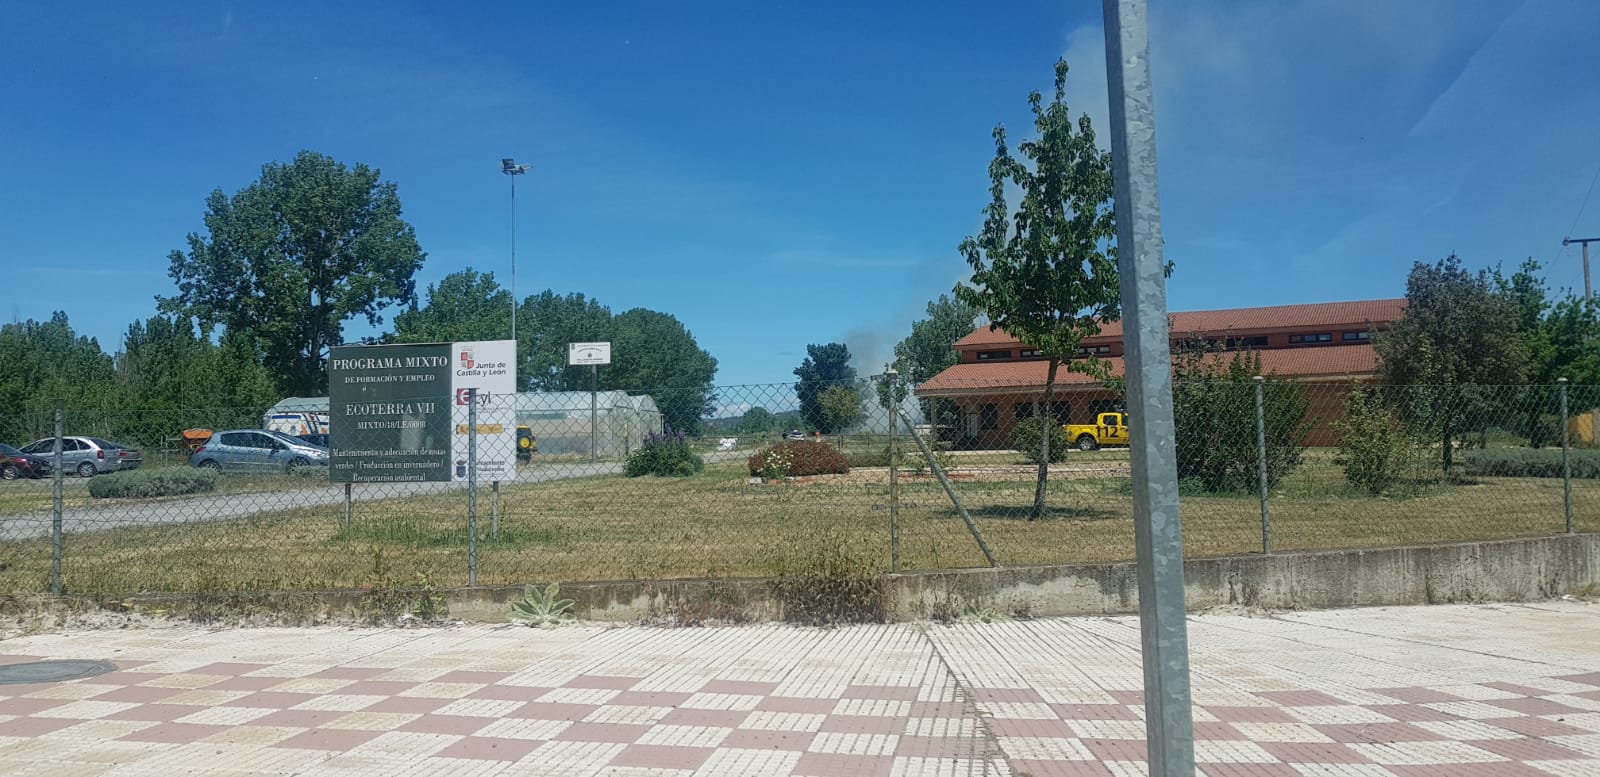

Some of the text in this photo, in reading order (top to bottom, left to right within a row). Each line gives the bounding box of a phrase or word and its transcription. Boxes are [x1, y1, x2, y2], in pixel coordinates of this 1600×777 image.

[333, 356, 448, 370] PROGRAMA MIXTO
[356, 373, 398, 383] FORMACIÓN
[406, 374, 435, 382] EMPLEO
[456, 369, 480, 377] Castilla
[346, 402, 435, 416] ECOTERRA VII
[1096, 426, 1119, 438] 112
[332, 448, 378, 457] Mantenimiento
[384, 446, 419, 457] adecuación
[420, 446, 428, 455] de
